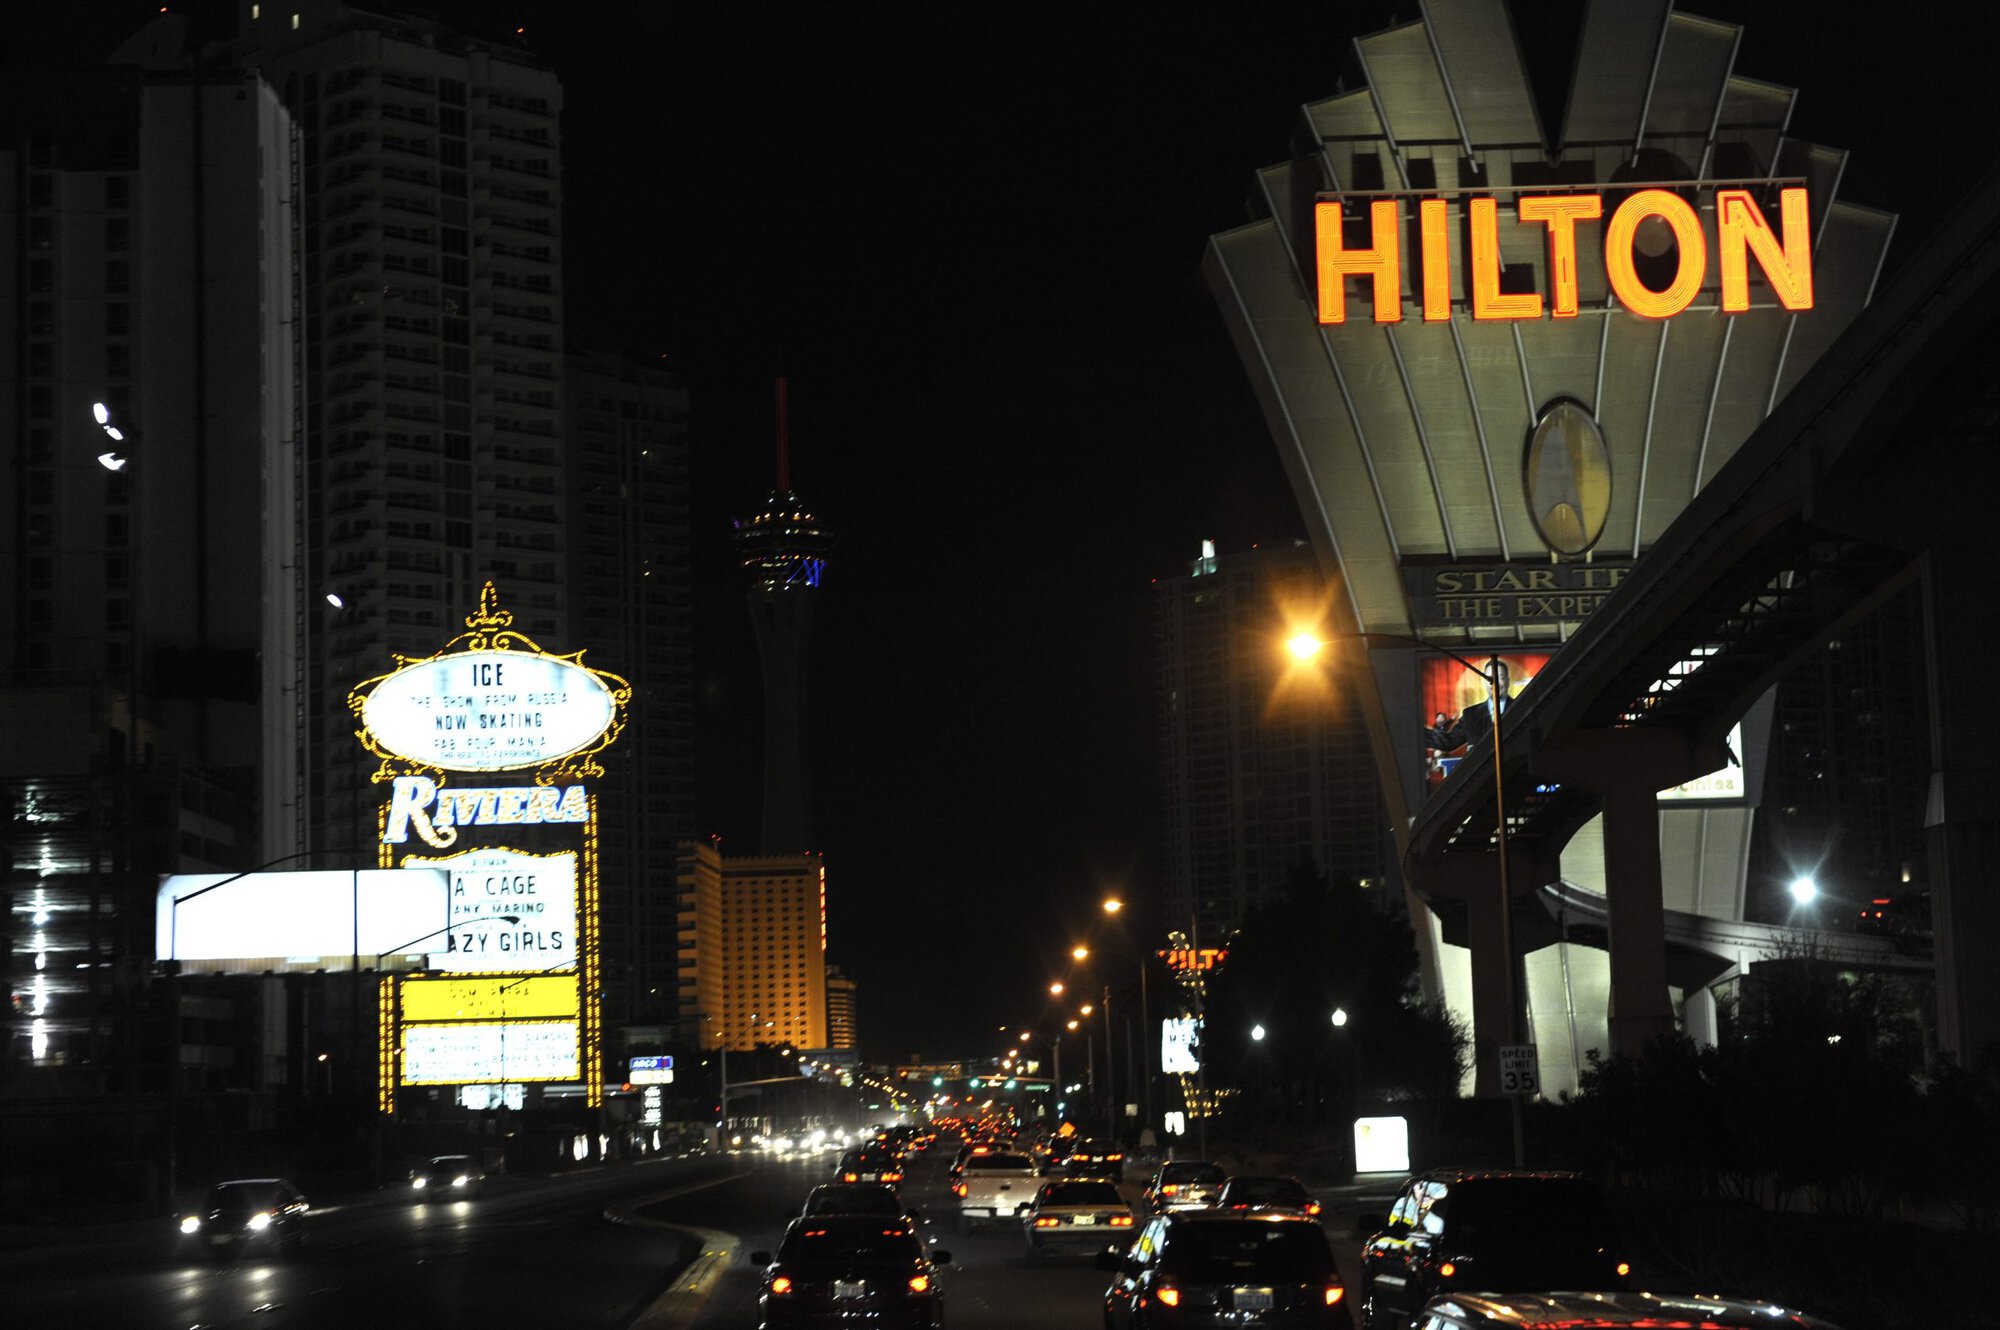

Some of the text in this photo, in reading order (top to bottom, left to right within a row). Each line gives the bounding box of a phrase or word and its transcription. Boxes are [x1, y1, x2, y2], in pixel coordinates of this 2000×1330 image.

[1313, 186, 1815, 325] HILTON
[1434, 567, 1632, 592] STAR TR
[1438, 596, 1606, 620] THE EXPE
[472, 663, 504, 687] ICE
[442, 695, 473, 708] SHOW
[485, 694, 517, 707] FROM
[528, 692, 568, 706] RUSSIA
[435, 712, 542, 731] NOW SKATING
[434, 737, 456, 751] FAB
[507, 735, 546, 748] MANIA
[485, 875, 536, 896] CAGE
[492, 902, 545, 914] MARINO
[450, 930, 563, 953] AZY GIRLS
[1501, 1049, 1535, 1060] SPEED
[1504, 1060, 1532, 1070] LIMIT
[1504, 1072, 1536, 1091] 35
